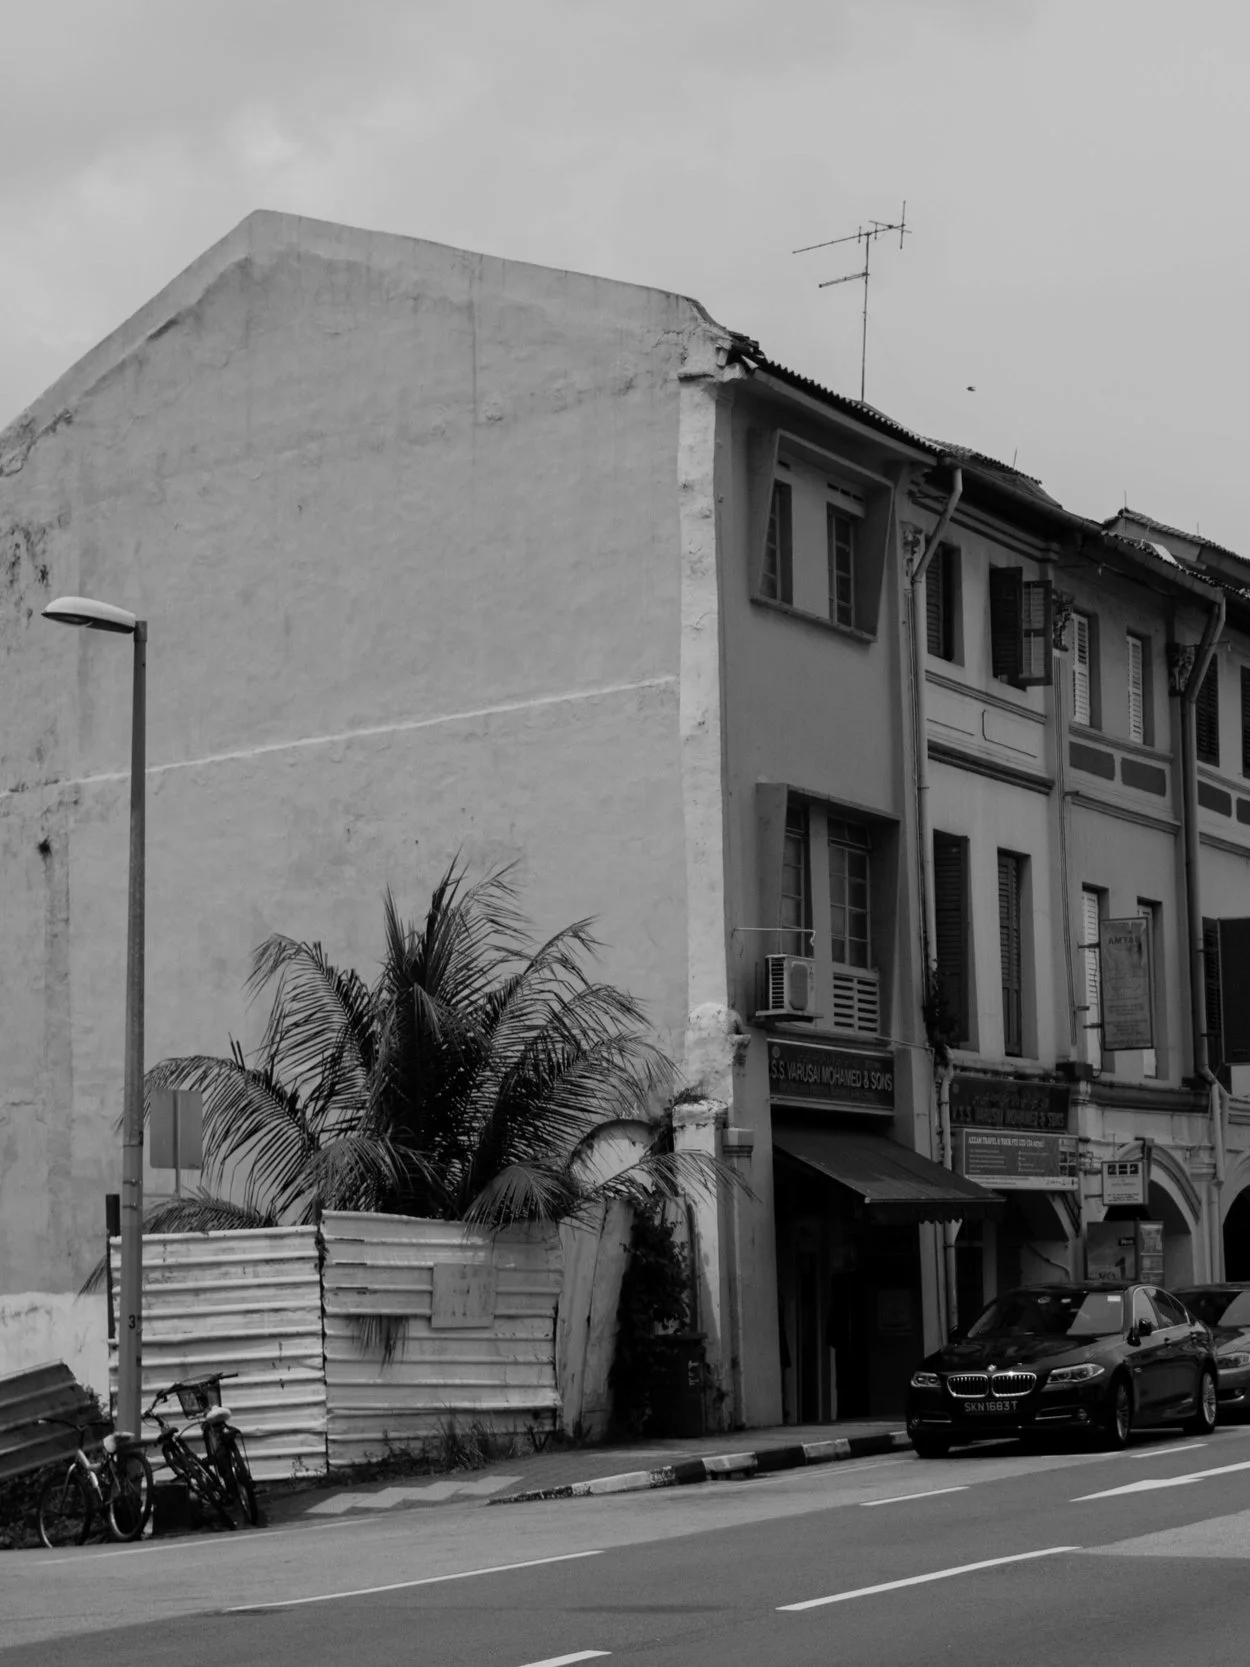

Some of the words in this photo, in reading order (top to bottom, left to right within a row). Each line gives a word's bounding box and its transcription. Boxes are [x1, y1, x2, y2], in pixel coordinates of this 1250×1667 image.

[787, 1061, 820, 1083] VARUSAI
[821, 1065, 862, 1088] MOHAMED
[863, 1069, 869, 1089] &
[870, 1071, 892, 1092] SONS
